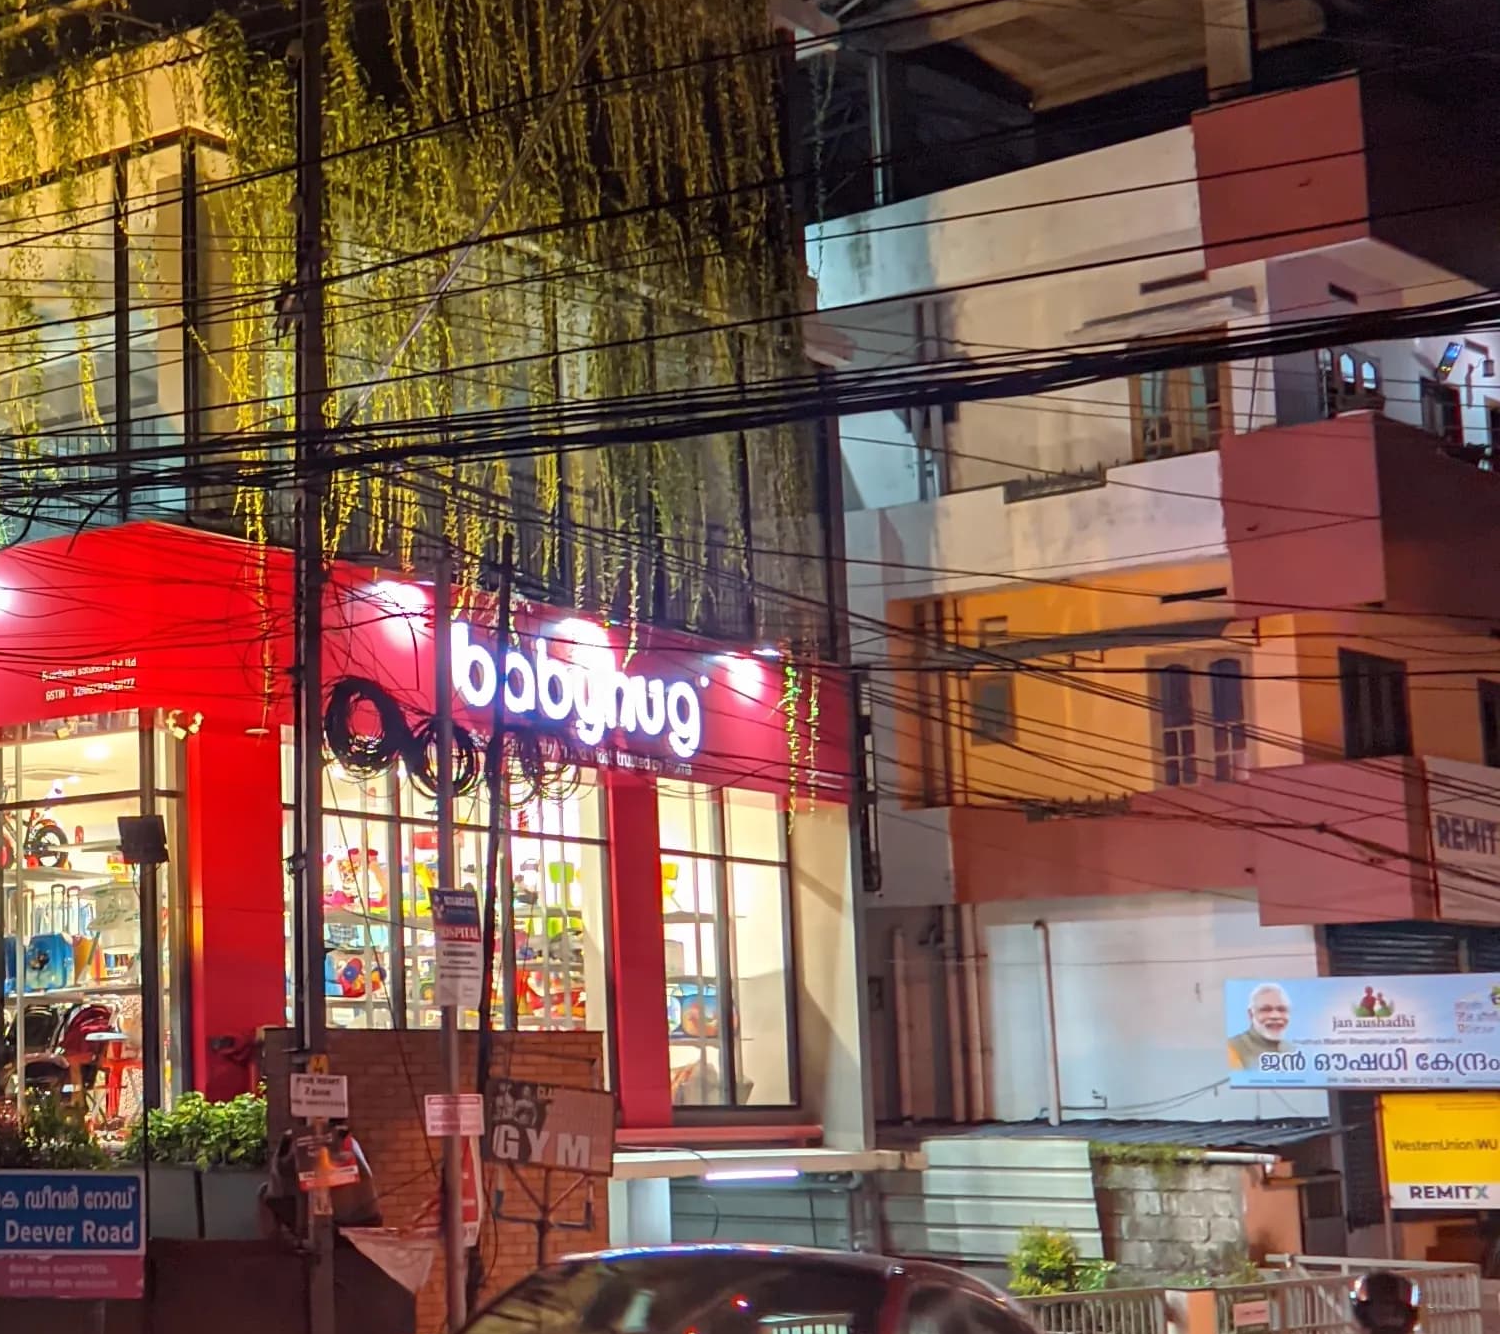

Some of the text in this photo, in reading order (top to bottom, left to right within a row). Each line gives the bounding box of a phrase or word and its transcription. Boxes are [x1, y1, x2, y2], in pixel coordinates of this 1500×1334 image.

[451, 622, 700, 757] babyhug
[1332, 1014, 1416, 1032] jan aushadhi
[492, 1124, 591, 1169] GYM
[1409, 1185, 1489, 1199] REMITX
[5, 1220, 75, 1243] Deever
[83, 1220, 135, 1243] Road
